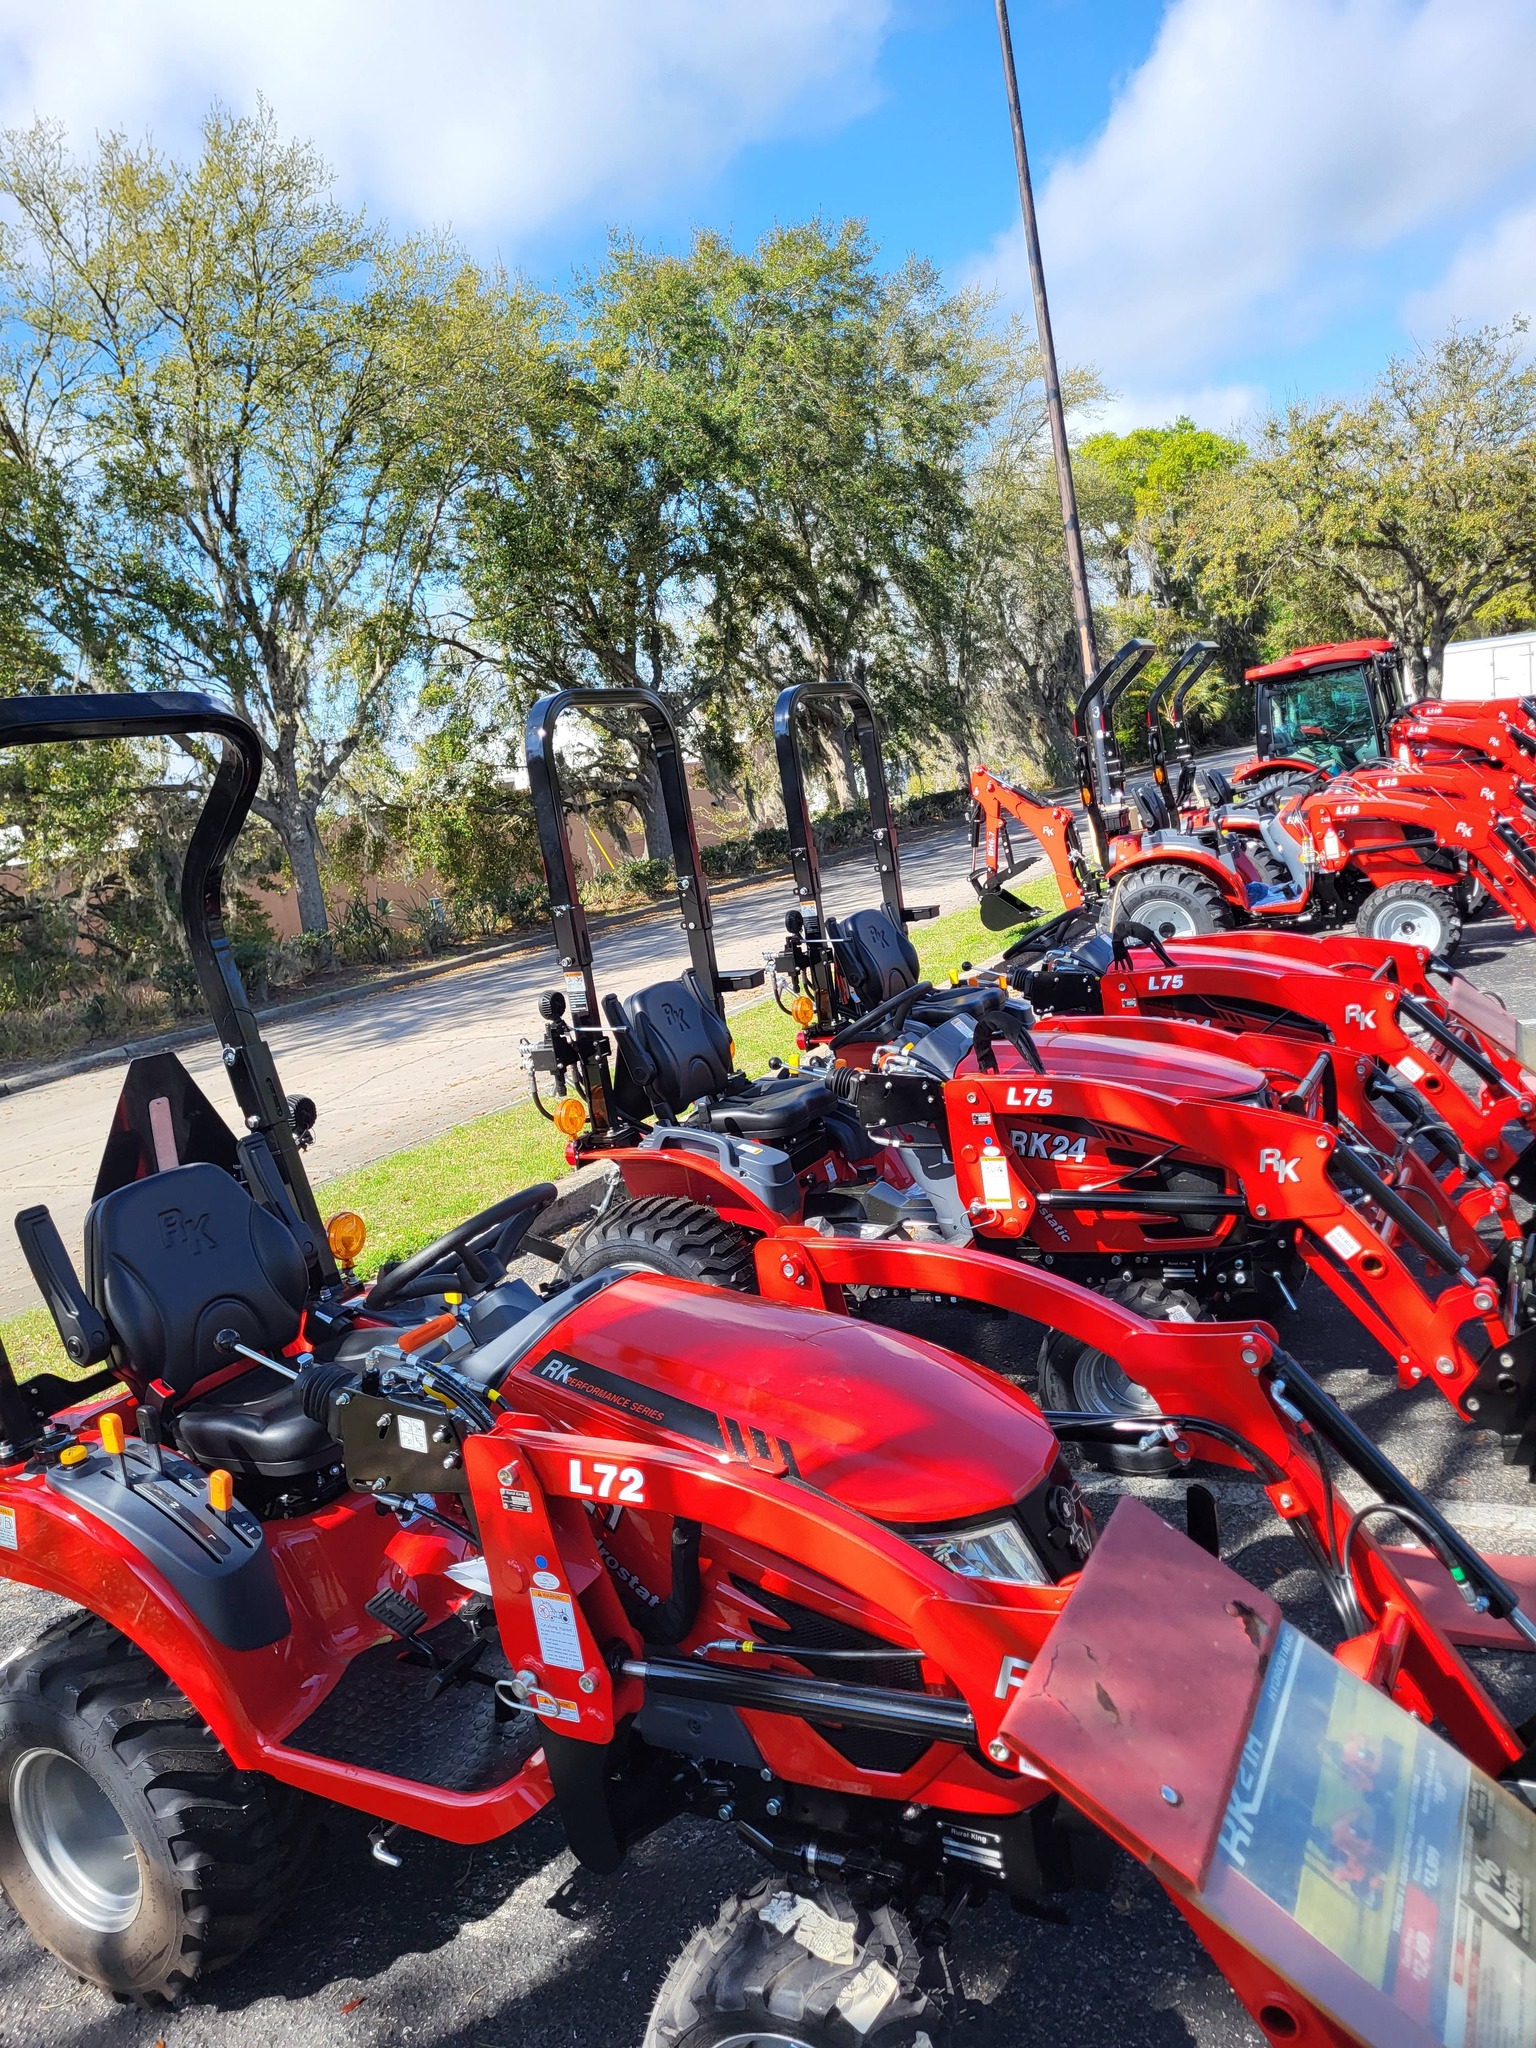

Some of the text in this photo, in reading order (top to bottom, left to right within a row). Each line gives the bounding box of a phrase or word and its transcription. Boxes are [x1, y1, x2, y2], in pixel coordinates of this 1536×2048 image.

[1480, 787, 1496, 801] RK
[1335, 805, 1360, 816] L85
[1042, 825, 1055, 837] RK
[1455, 821, 1474, 838] RK
[867, 925, 890, 948] RK
[1148, 975, 1184, 991] L75
[661, 1002, 691, 1032] RK
[1345, 1003, 1377, 1031] RK
[1006, 1086, 1053, 1107] L75
[1010, 1130, 1087, 1163] RK24
[1259, 1148, 1302, 1184] RK
[157, 1207, 217, 1256] RK
[1038, 1204, 1071, 1243] static
[540, 1358, 665, 1421] RK PERFORMANCE SERIES
[568, 1458, 645, 1503] L72
[1267, 1630, 1294, 1702] HYDROSTATIC
[950, 1827, 987, 1844] Rural King
